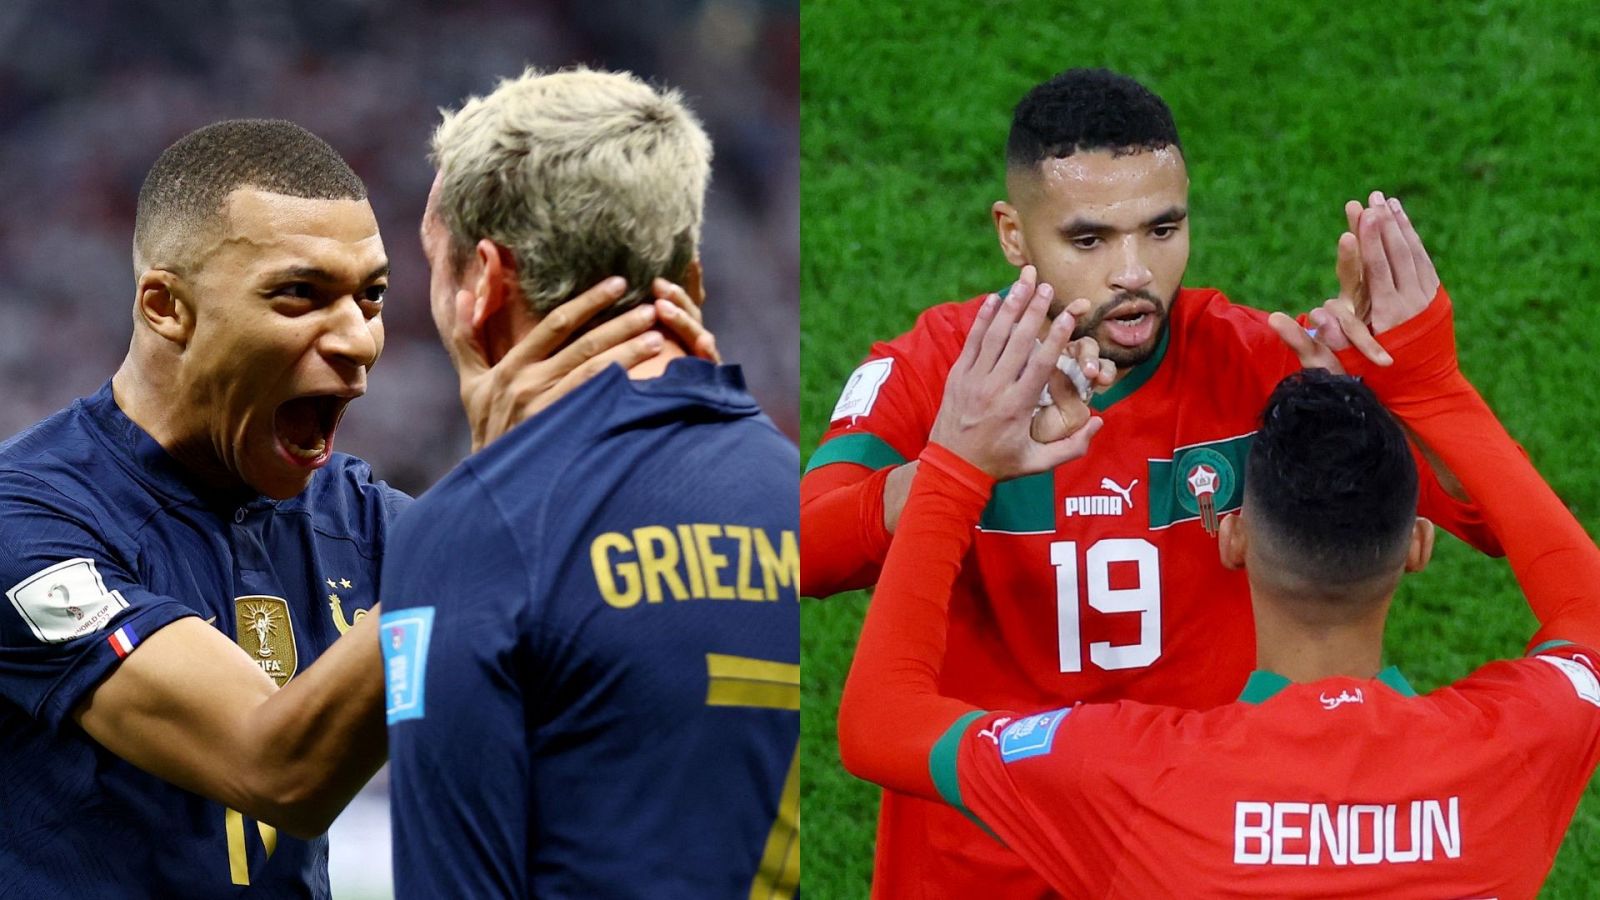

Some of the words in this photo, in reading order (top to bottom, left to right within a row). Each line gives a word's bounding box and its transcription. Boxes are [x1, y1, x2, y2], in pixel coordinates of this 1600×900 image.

[1065, 495, 1123, 517] PUMA
[590, 523, 800, 609] GRIEZM
[97, 605, 109, 617] CUP
[1050, 538, 1162, 673] 19
[1233, 796, 1461, 866] BENOUN
